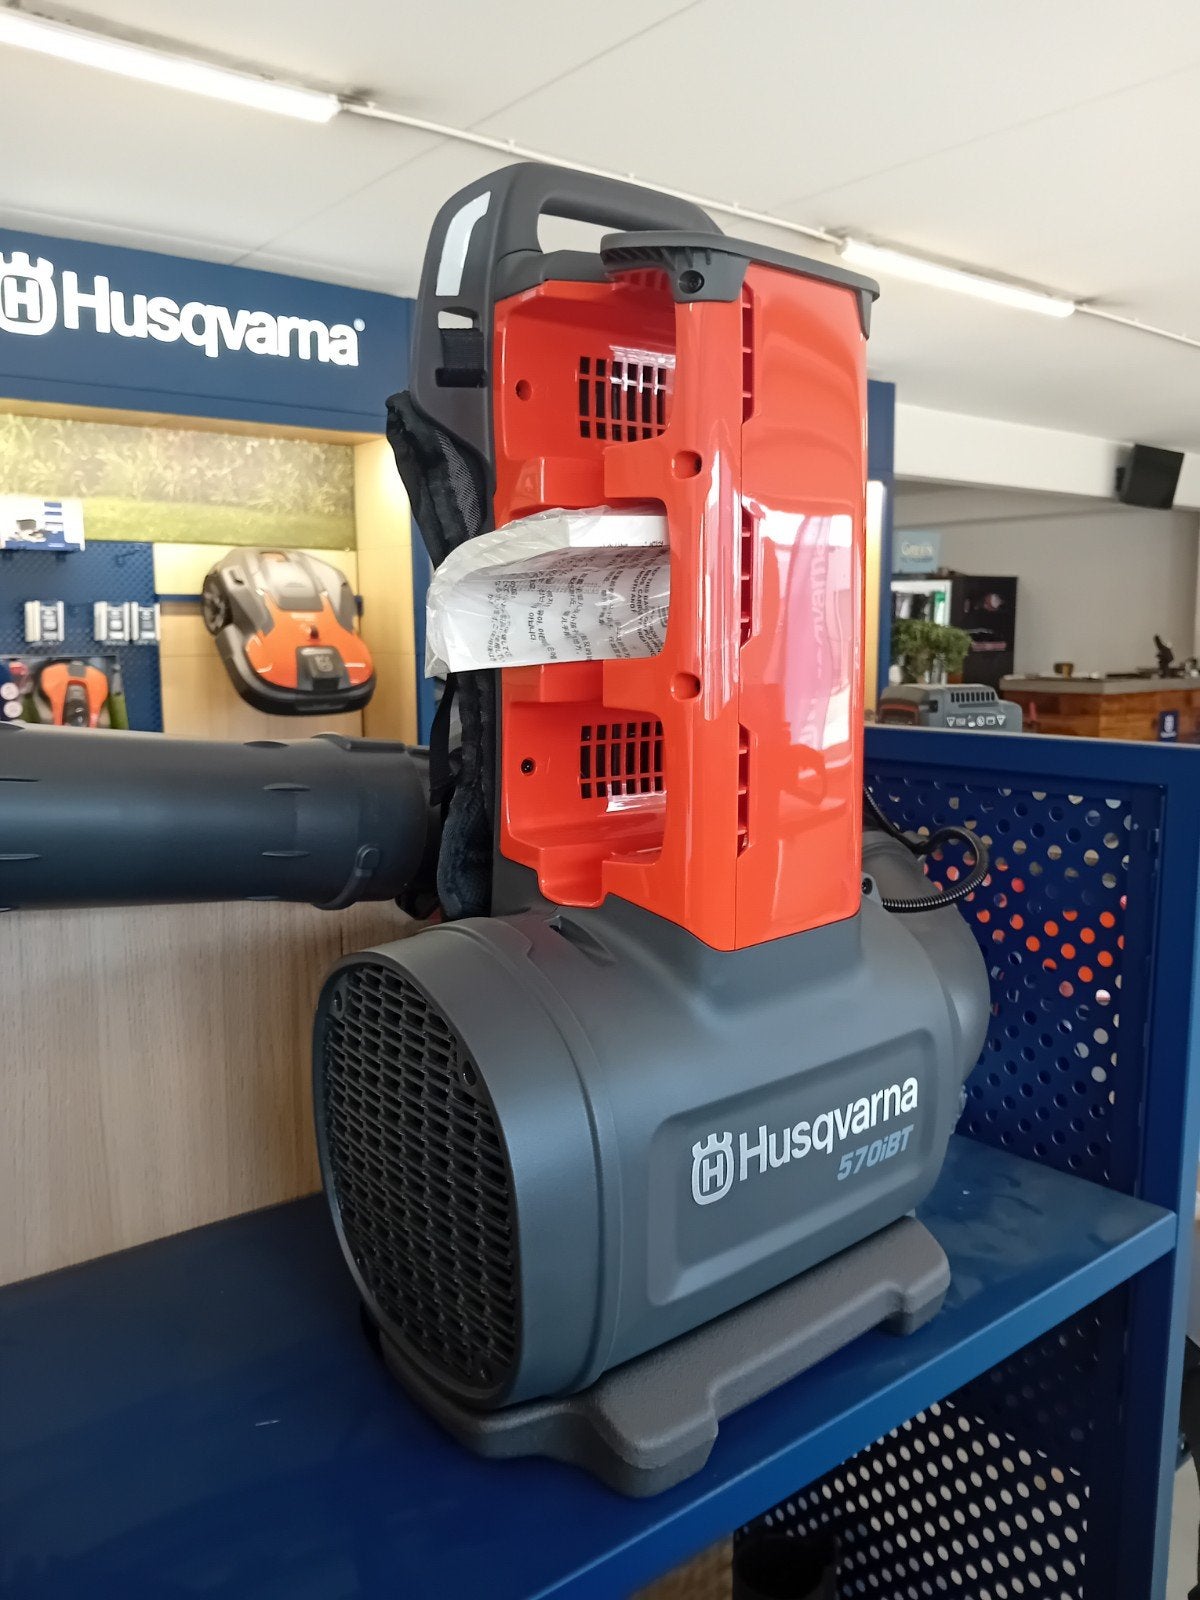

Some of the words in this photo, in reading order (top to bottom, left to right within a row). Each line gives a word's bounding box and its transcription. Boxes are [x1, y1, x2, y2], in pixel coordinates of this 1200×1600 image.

[62, 270, 360, 367] Husqvarna
[738, 1075, 919, 1182] Husqvarna
[837, 1124, 915, 1181] 570iBT
